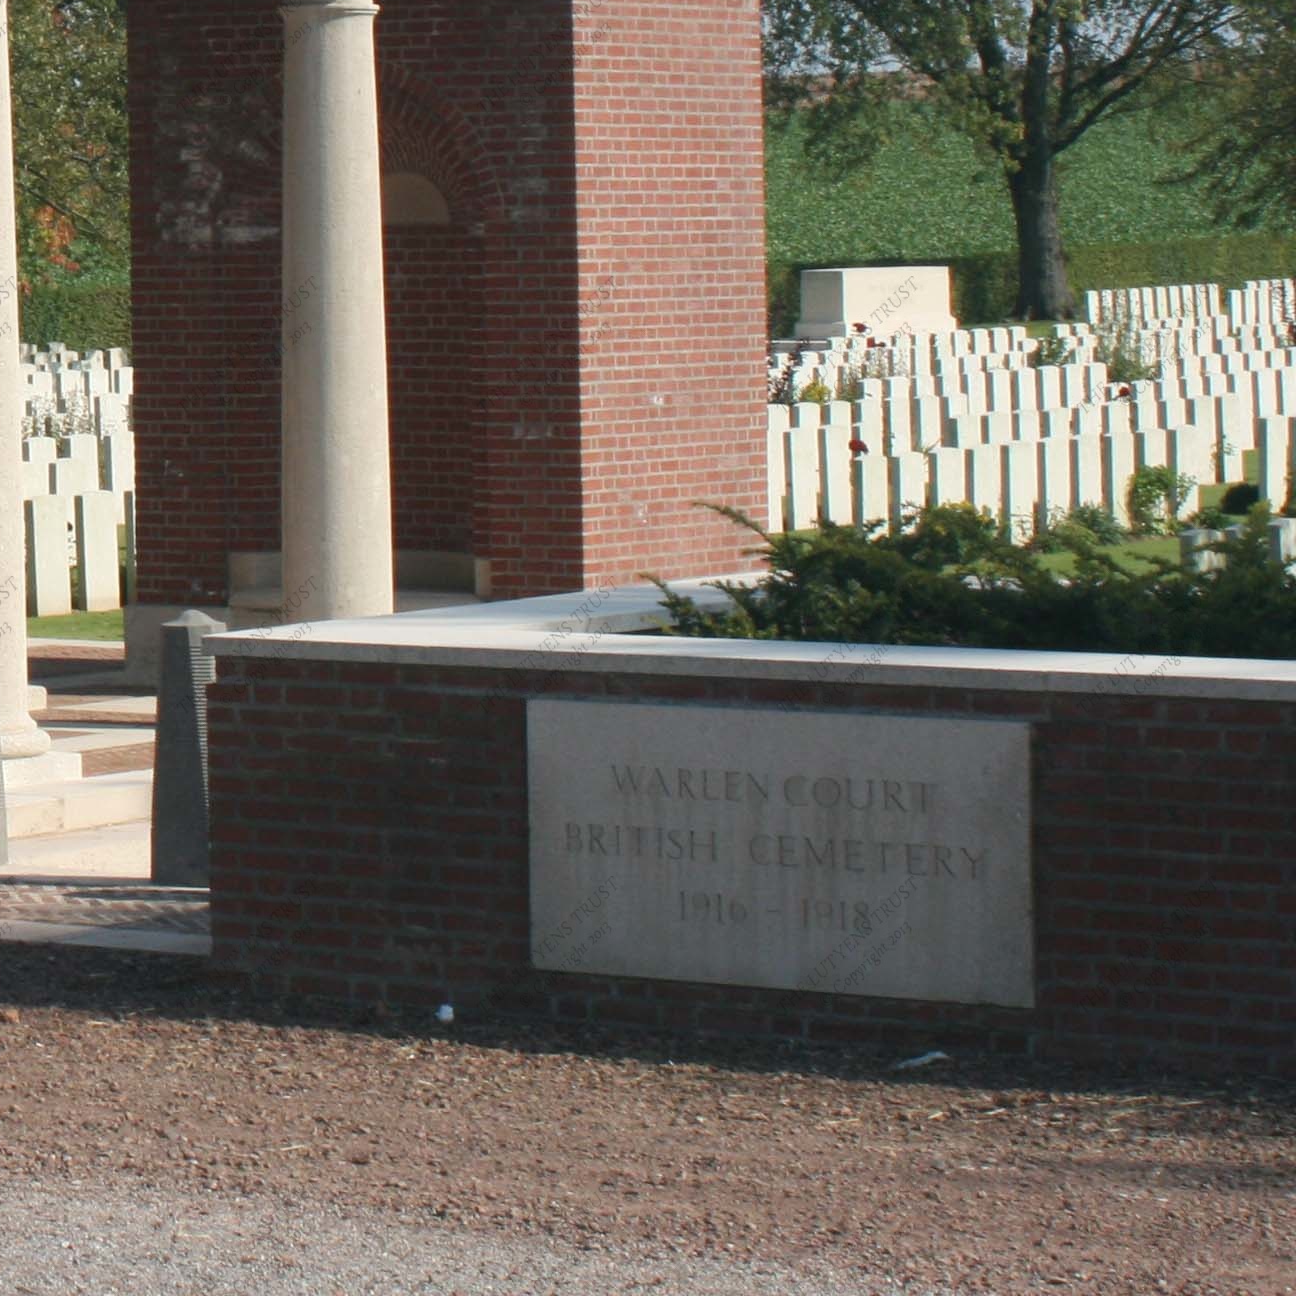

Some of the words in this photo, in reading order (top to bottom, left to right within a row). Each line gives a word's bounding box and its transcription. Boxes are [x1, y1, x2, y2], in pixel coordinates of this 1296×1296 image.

[564, 821, 719, 863] BRITISH
[749, 832, 991, 882] CEMETERY
[800, 896, 872, 931] 1918
